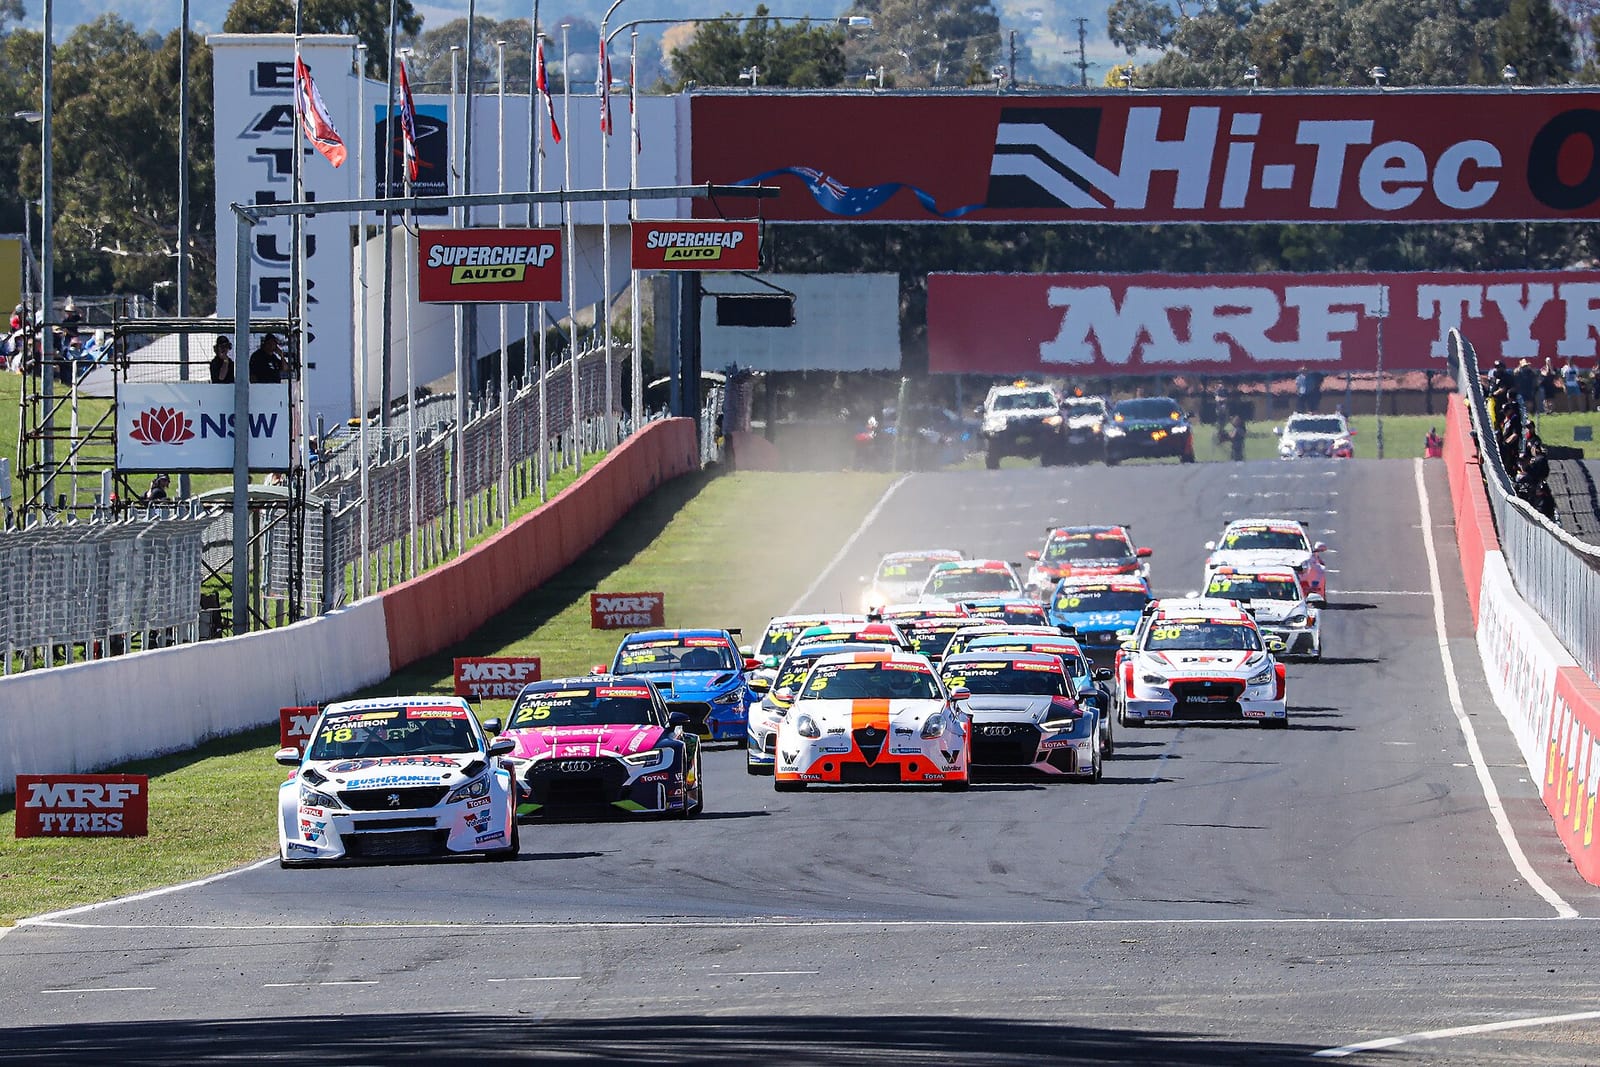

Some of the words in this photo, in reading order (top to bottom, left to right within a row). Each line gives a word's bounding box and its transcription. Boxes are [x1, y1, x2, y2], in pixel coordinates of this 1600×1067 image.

[1114, 106, 1502, 209] Hi-Tec
[1527, 108, 1600, 210] O
[251, 61, 320, 368] BATUR
[647, 231, 744, 248] SUPERCHEAP
[428, 245, 555, 268] SUPERCHEAP
[671, 249, 721, 258] AUTO
[461, 267, 516, 280] AUTO
[1040, 286, 1389, 364] MRF
[596, 597, 659, 613] MRF
[604, 613, 650, 625] TYRES
[1153, 629, 1180, 640] 30
[622, 654, 656, 666] 333
[460, 663, 536, 681] MRF
[960, 669, 999, 677] Tander
[469, 682, 525, 696] TYRES
[810, 678, 828, 691] 5
[520, 699, 572, 710] C.Mostert
[516, 705, 551, 724] 25
[322, 719, 388, 732] A.CAMERON
[320, 728, 352, 744] 18
[25, 783, 139, 808] MRF
[468, 799, 490, 808] TOTAL
[39, 812, 123, 832] TYRES
